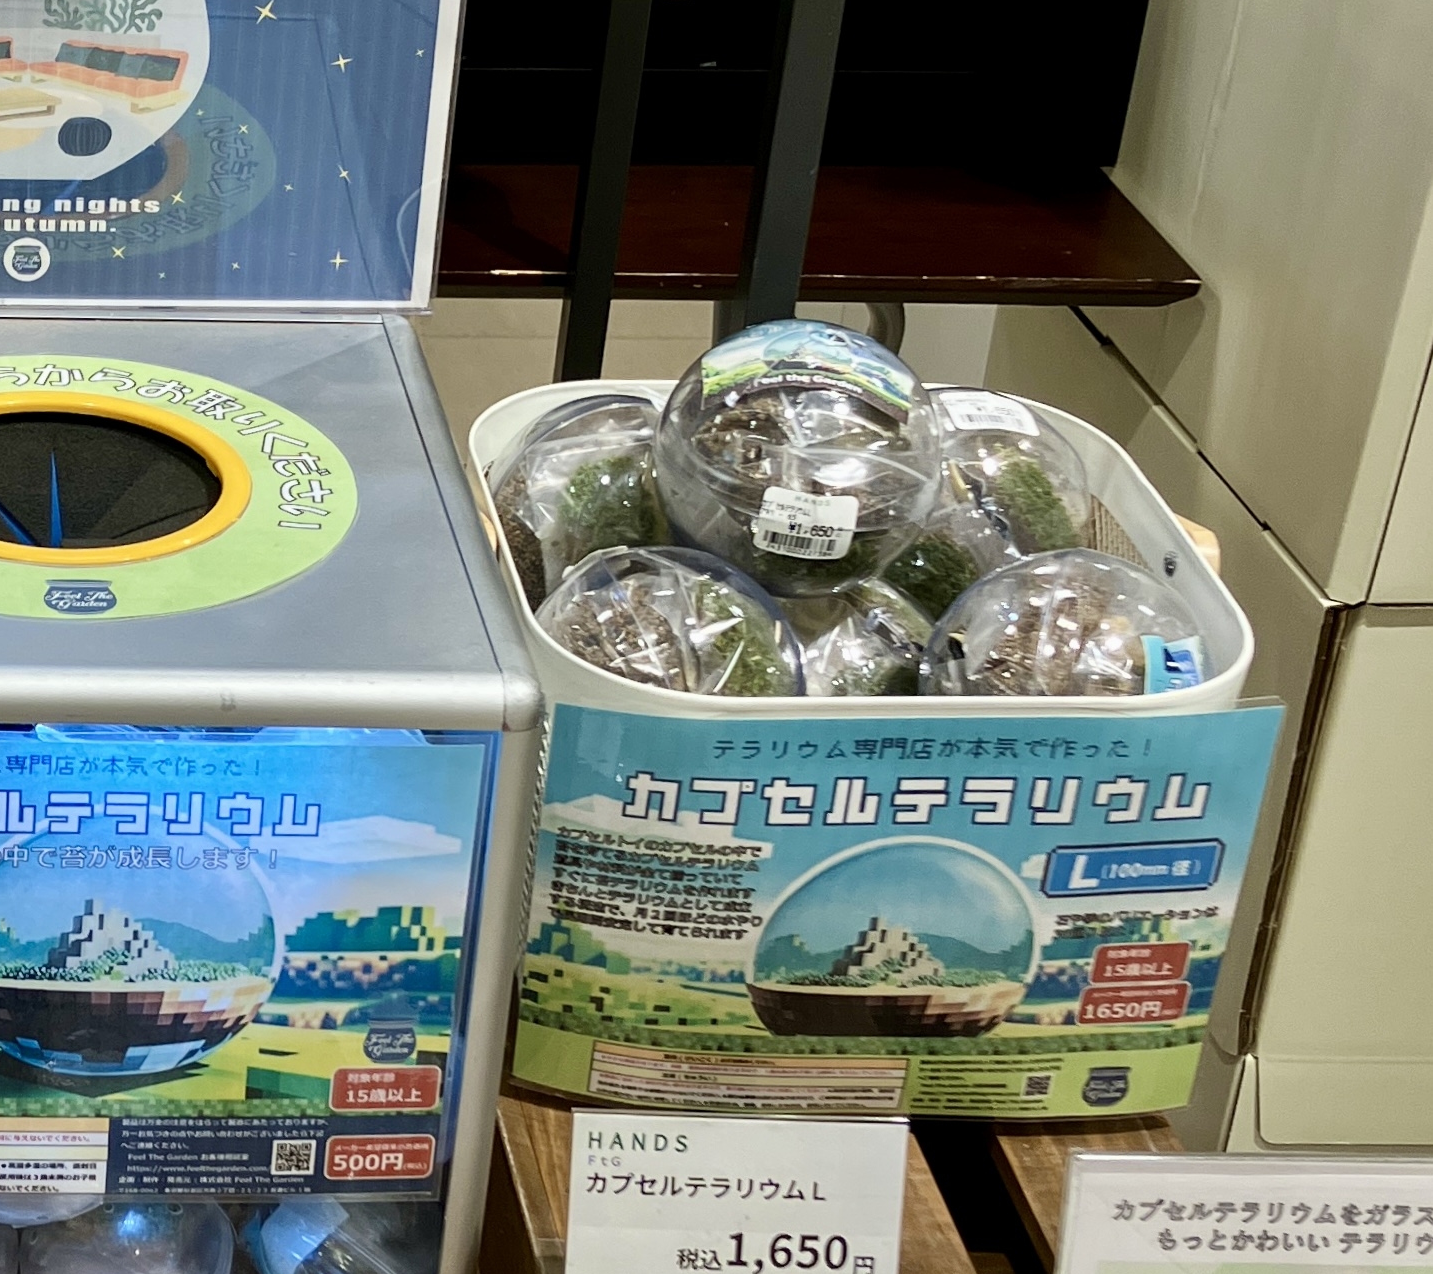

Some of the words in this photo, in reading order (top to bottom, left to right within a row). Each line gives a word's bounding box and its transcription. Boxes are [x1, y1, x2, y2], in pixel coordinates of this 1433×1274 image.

[53, 194, 161, 218] nights
[786, 374, 811, 382] the
[713, 736, 1153, 761] テラリウム専門店が本気で作った！
[623, 771, 1211, 826] カプセルテラリウム
[1068, 855, 1099, 889] L
[1083, 1001, 1162, 1019] 1650円
[346, 1089, 423, 1103] 15歳以上
[588, 1131, 688, 1153] HANDS
[333, 1153, 404, 1173] 500円
[586, 1172, 826, 1202] カプセルテラリウムL
[1157, 1229, 1330, 1253] もっとかわいい
